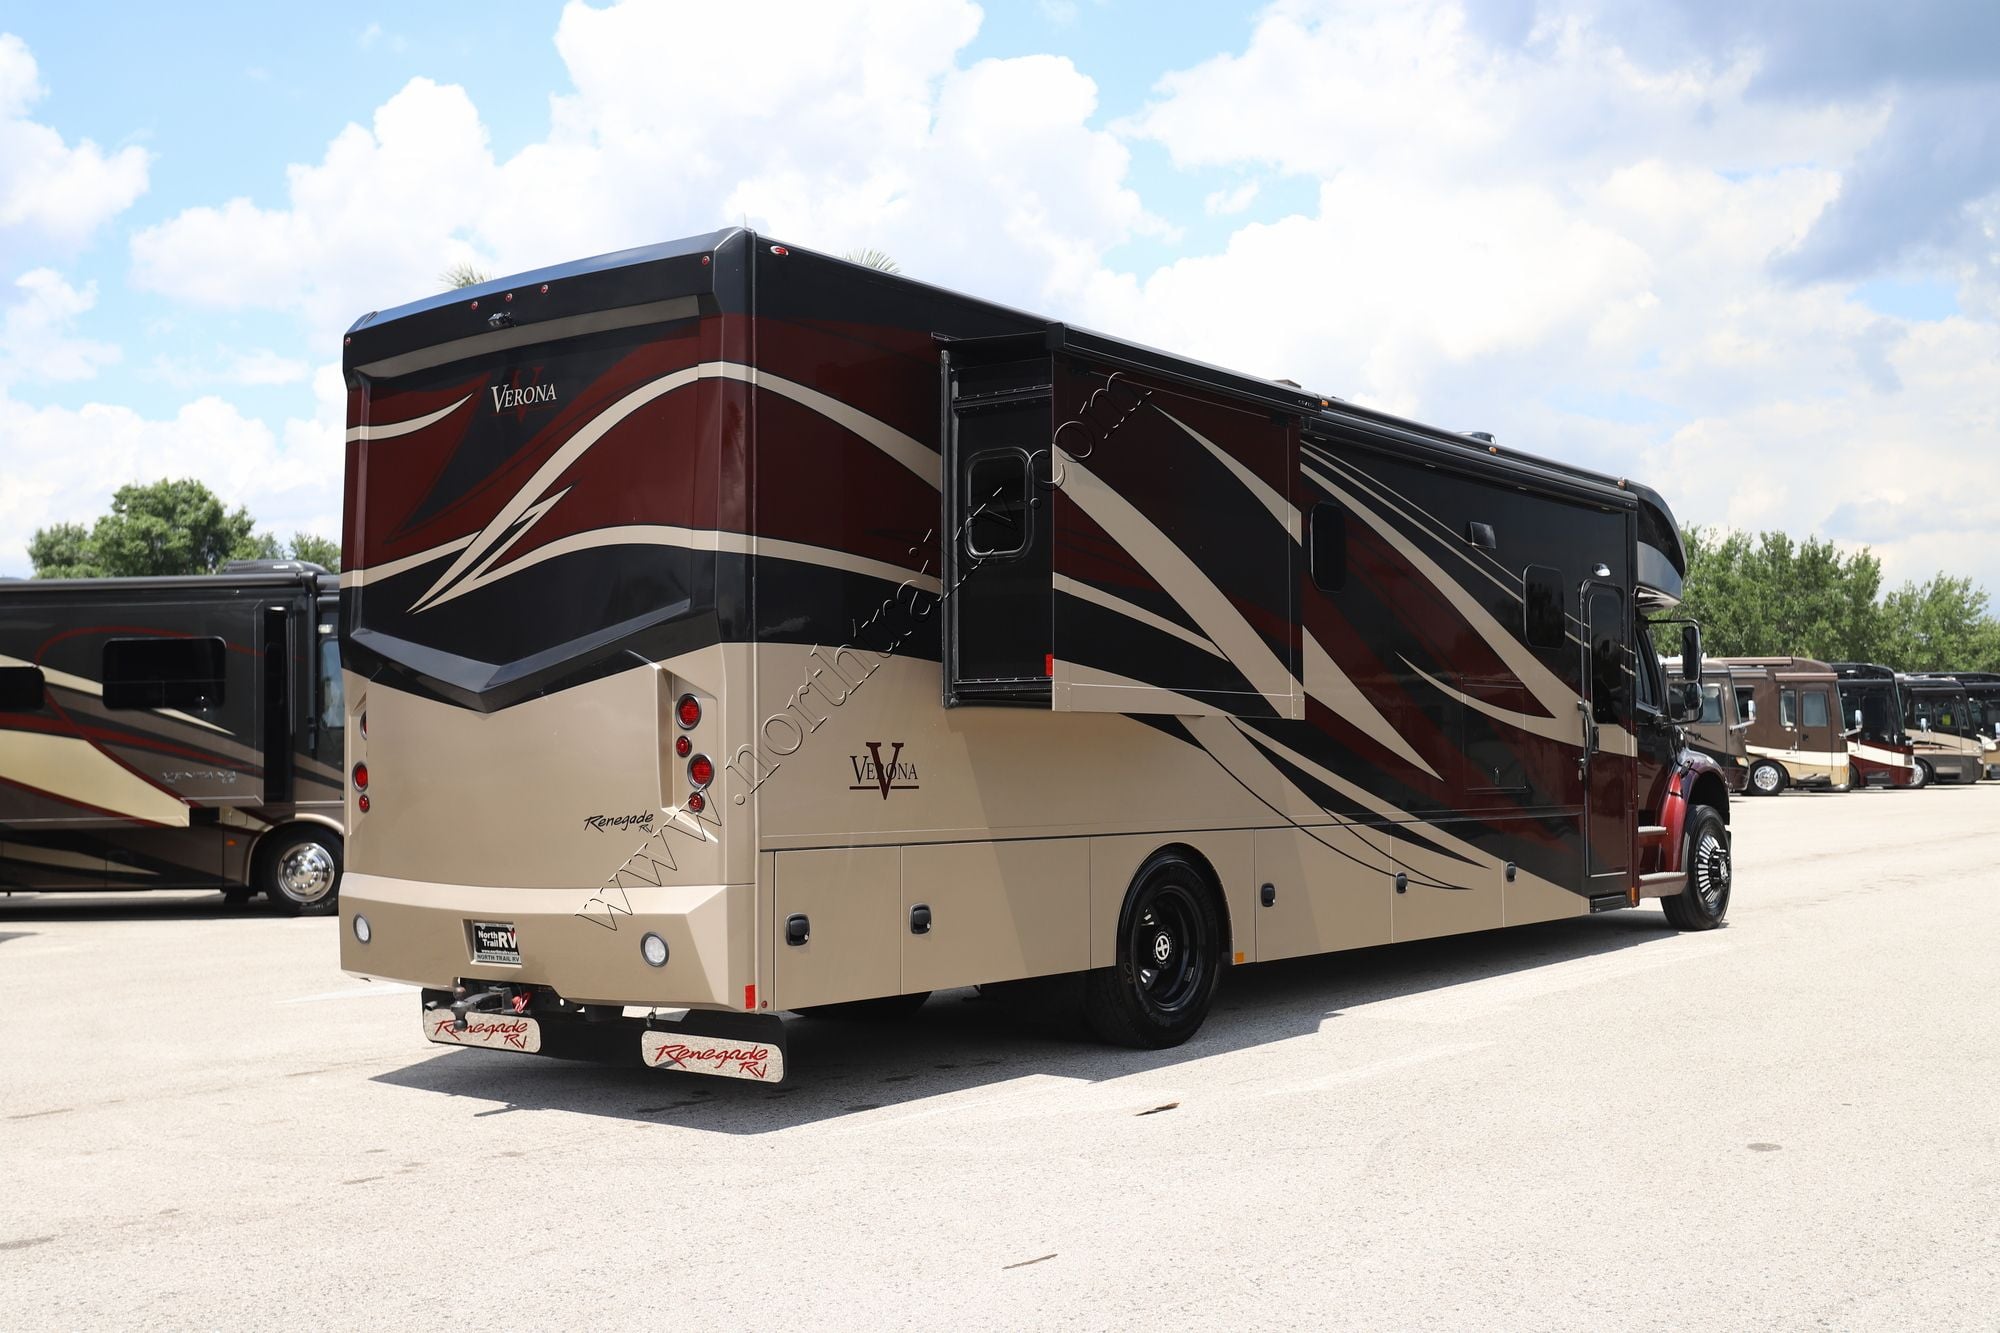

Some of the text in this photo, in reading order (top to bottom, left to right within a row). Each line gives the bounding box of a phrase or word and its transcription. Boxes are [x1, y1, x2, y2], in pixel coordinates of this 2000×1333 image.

[491, 383, 557, 413] VERONA
[583, 809, 654, 833] Renegade
[639, 823, 654, 834] RV
[478, 930, 498, 939] North
[482, 939, 498, 947] Trail
[498, 931, 517, 949] RV
[434, 1019, 528, 1041] Rnegade
[503, 1033, 528, 1049] RV
[655, 1044, 768, 1069] Renegade
[738, 1061, 767, 1079] RV
